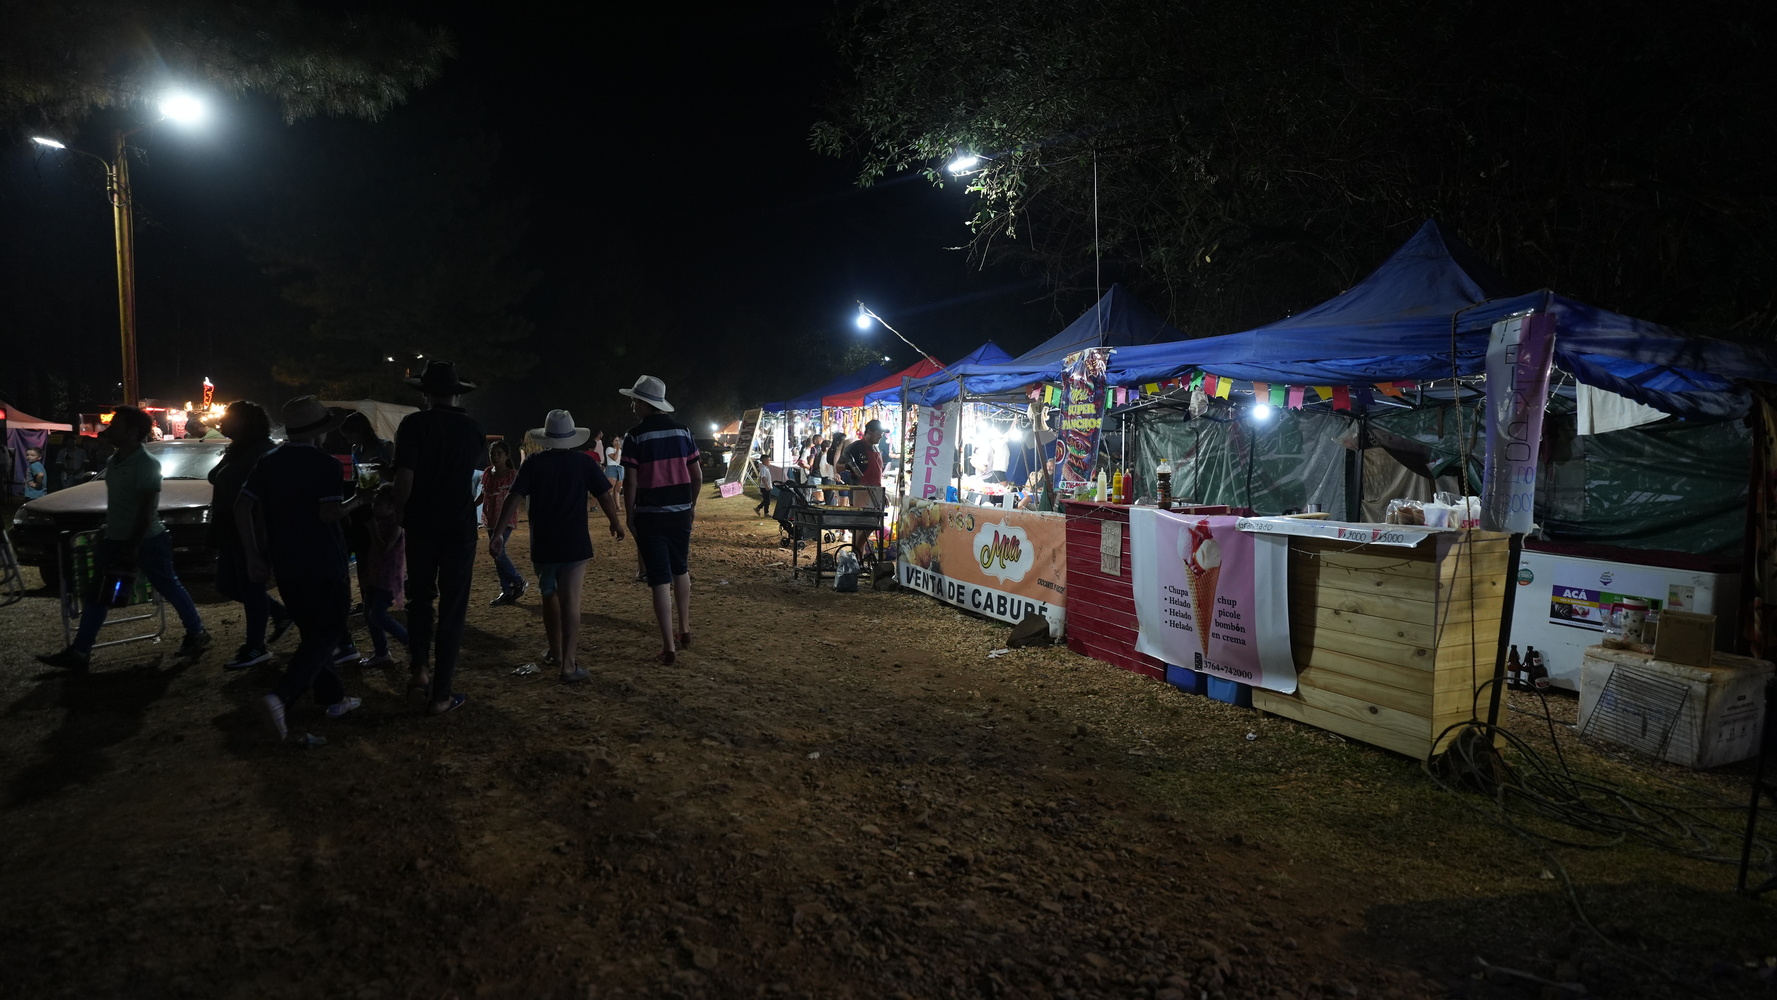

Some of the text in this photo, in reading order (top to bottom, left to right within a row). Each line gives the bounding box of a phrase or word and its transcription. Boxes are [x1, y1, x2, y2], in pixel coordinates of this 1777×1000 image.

[1068, 403, 1097, 415] SUPER
[1062, 418, 1102, 430] PANCHOS
[923, 403, 946, 499] HORIP
[980, 530, 1022, 569] Mili
[906, 566, 944, 597] VENTA
[948, 581, 965, 604] DE
[1168, 585, 1237, 608] Chupa chup
[1563, 589, 1588, 600] ACÁ
[1169, 597, 1241, 620] Helado picole
[1169, 608, 1246, 633] Helado bombón
[1169, 620, 1246, 645] Helado en crema
[1203, 660, 1253, 680] 3764-742000
